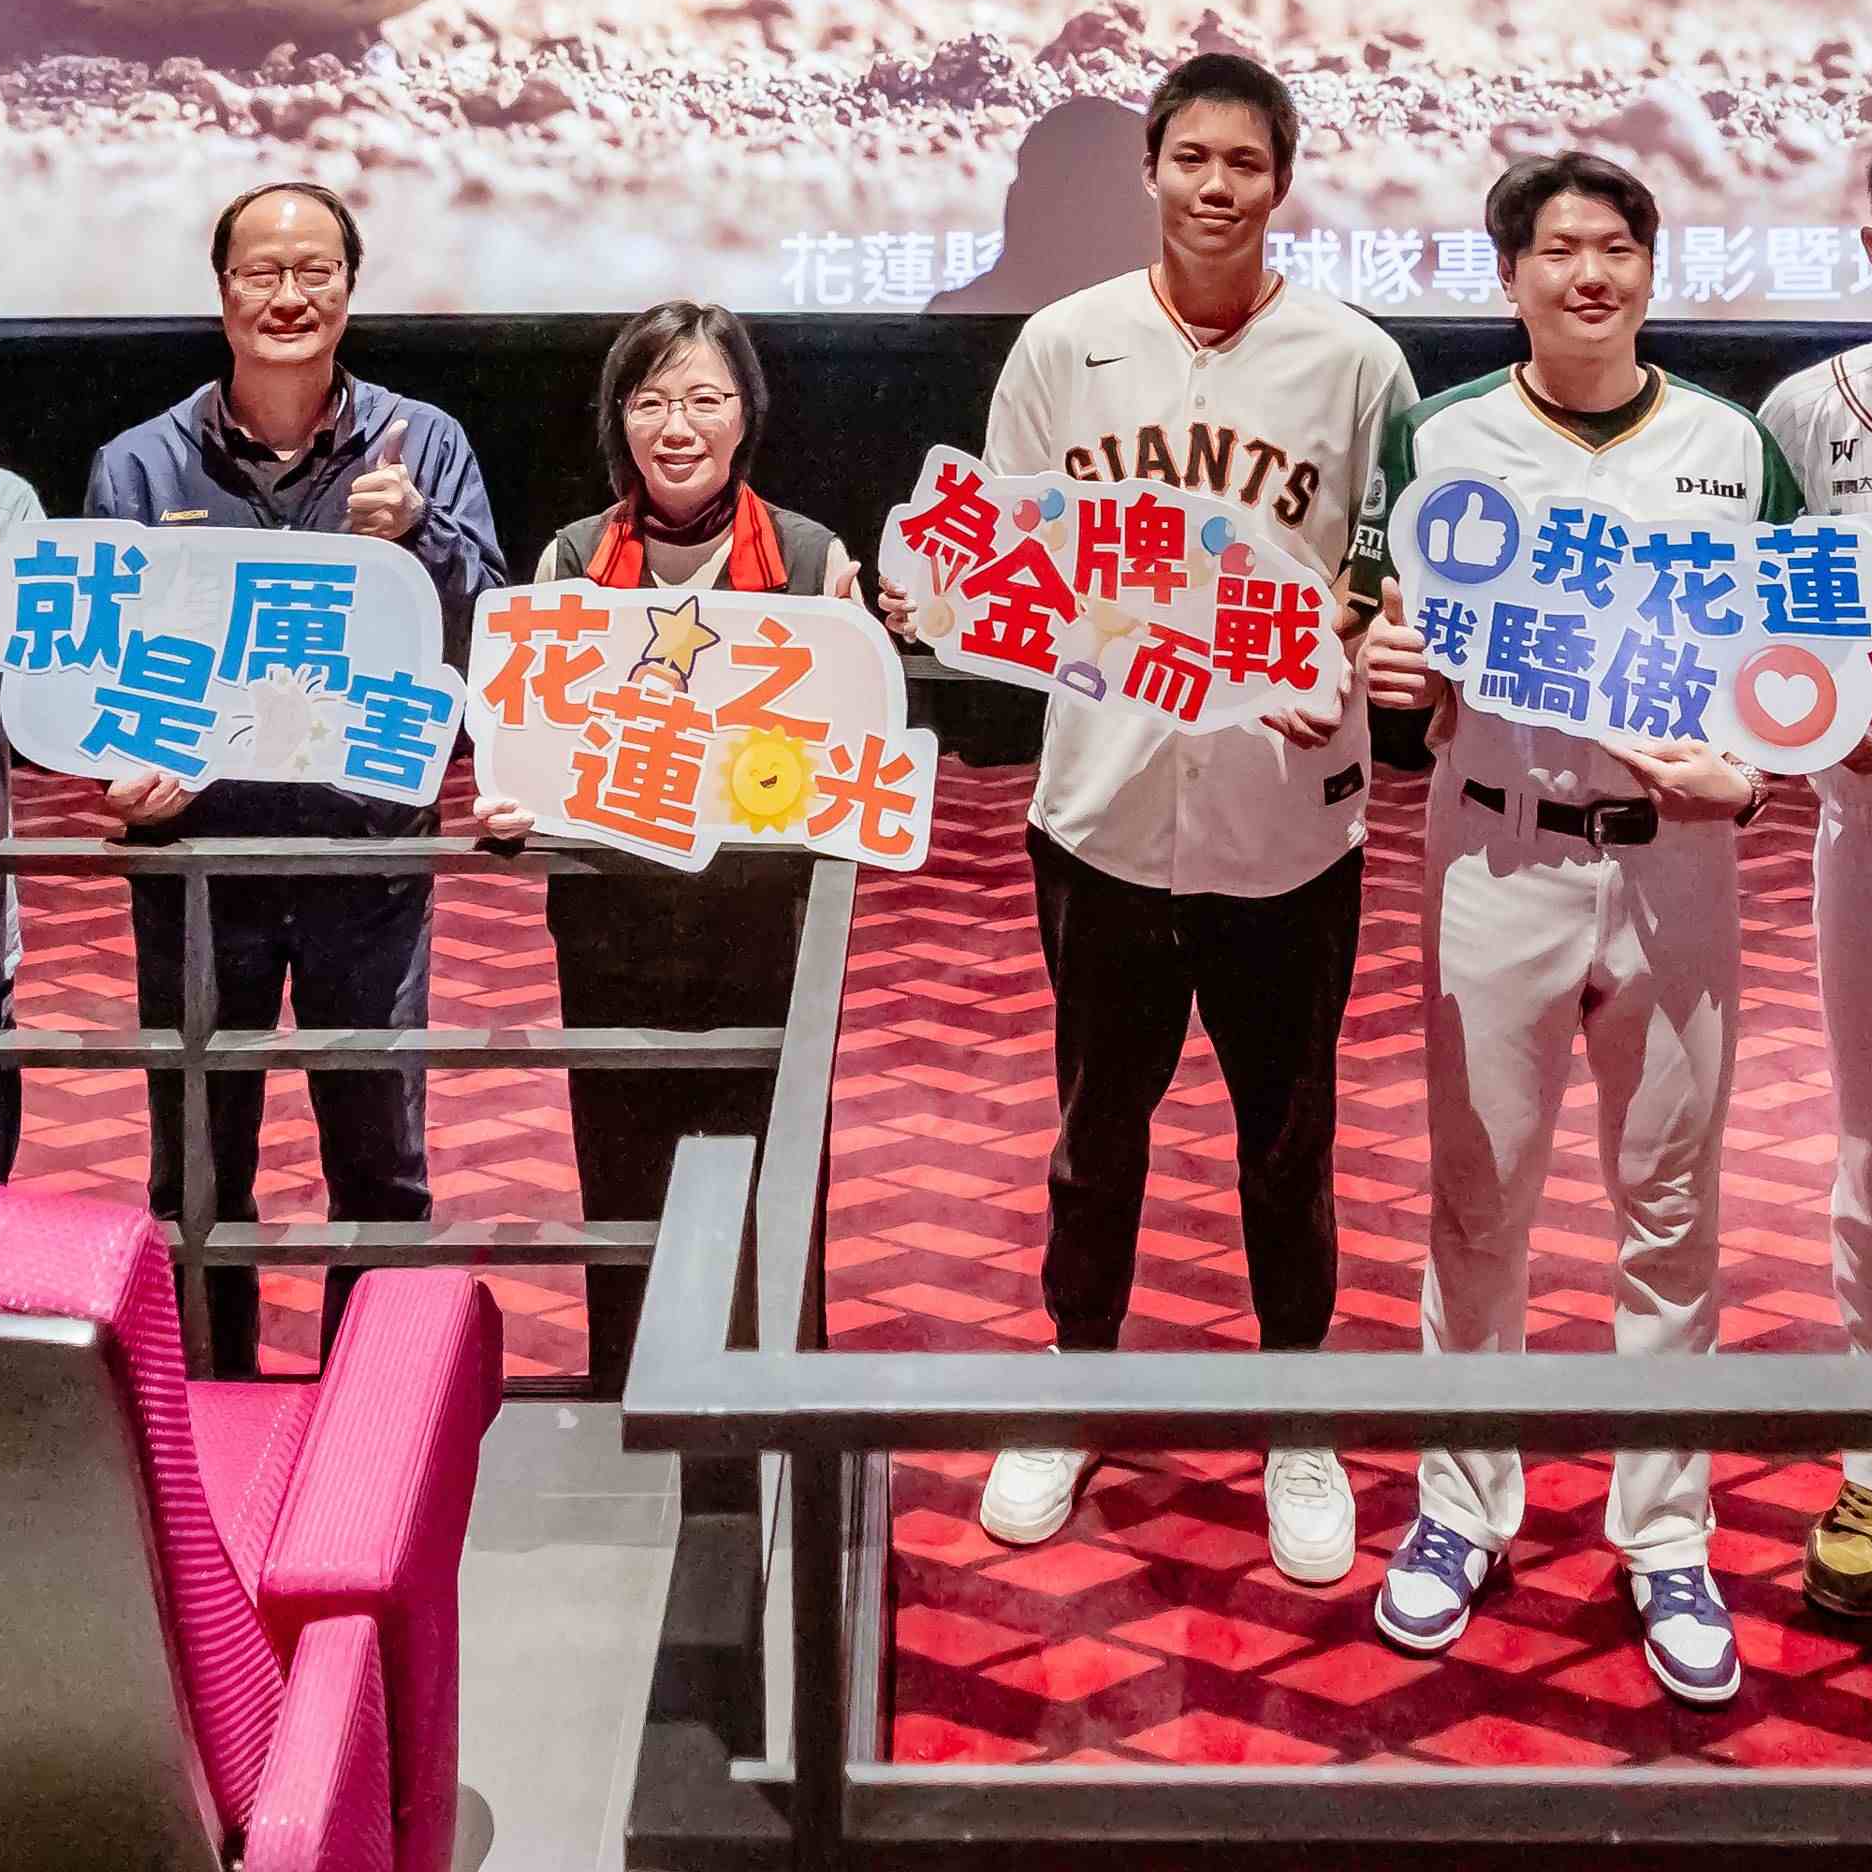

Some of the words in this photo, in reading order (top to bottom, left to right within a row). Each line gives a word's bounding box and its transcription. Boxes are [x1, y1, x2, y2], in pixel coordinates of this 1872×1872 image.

[1064, 421, 1321, 530] GIANTS
[1675, 476, 1747, 500] D-Link
[900, 461, 1323, 722] 為金牌而戰
[1531, 506, 1872, 640] 我花蓮
[5, 540, 453, 792] 就是厲害
[483, 593, 917, 856] 花蓮之光
[1415, 595, 1721, 742] 我驕傲
